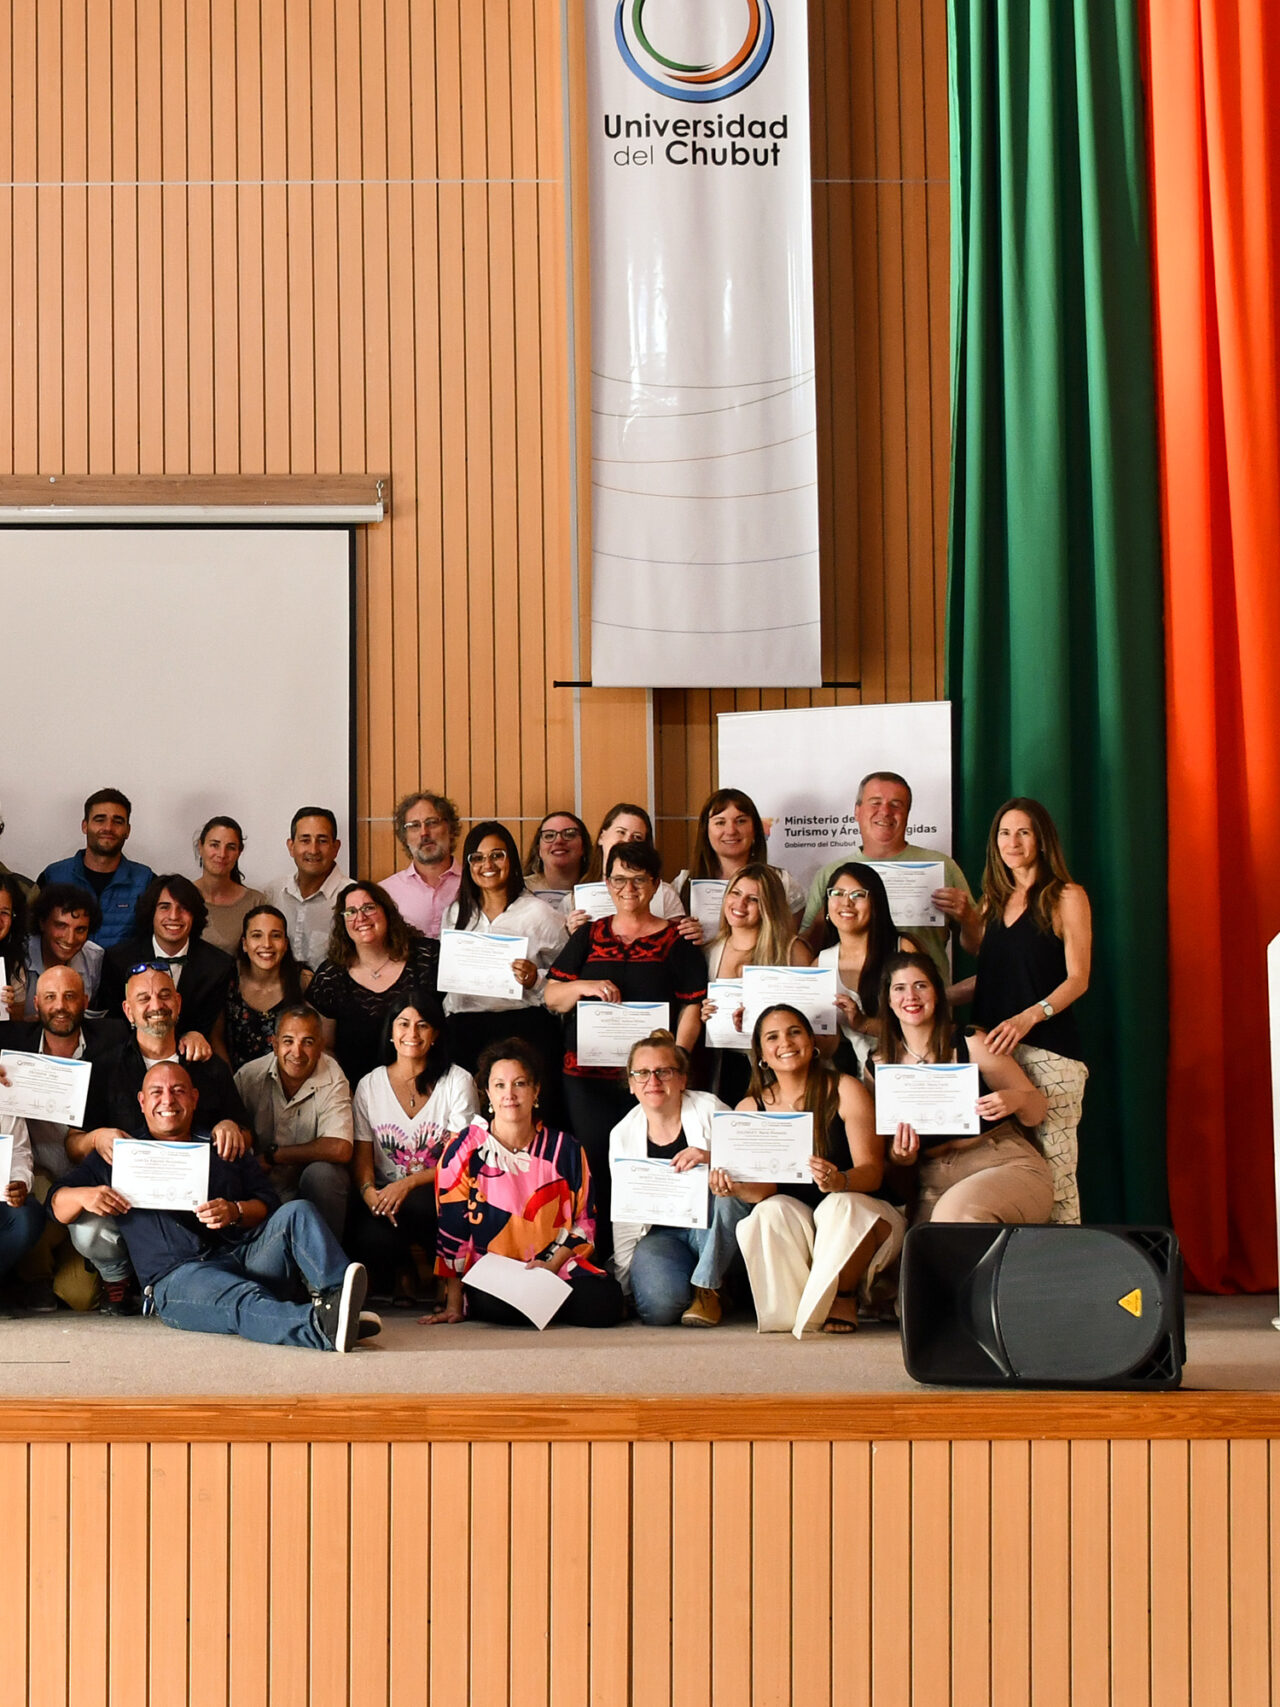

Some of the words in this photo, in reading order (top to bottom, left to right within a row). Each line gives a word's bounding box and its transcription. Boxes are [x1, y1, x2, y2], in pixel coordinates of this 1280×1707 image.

[604, 113, 788, 139] Universidad
[614, 145, 654, 166] del
[665, 140, 781, 166] Chubut
[784, 815, 839, 825] Ministerio
[841, 815, 856, 824] de
[784, 827, 829, 837] Turismo
[831, 828, 837, 837] y
